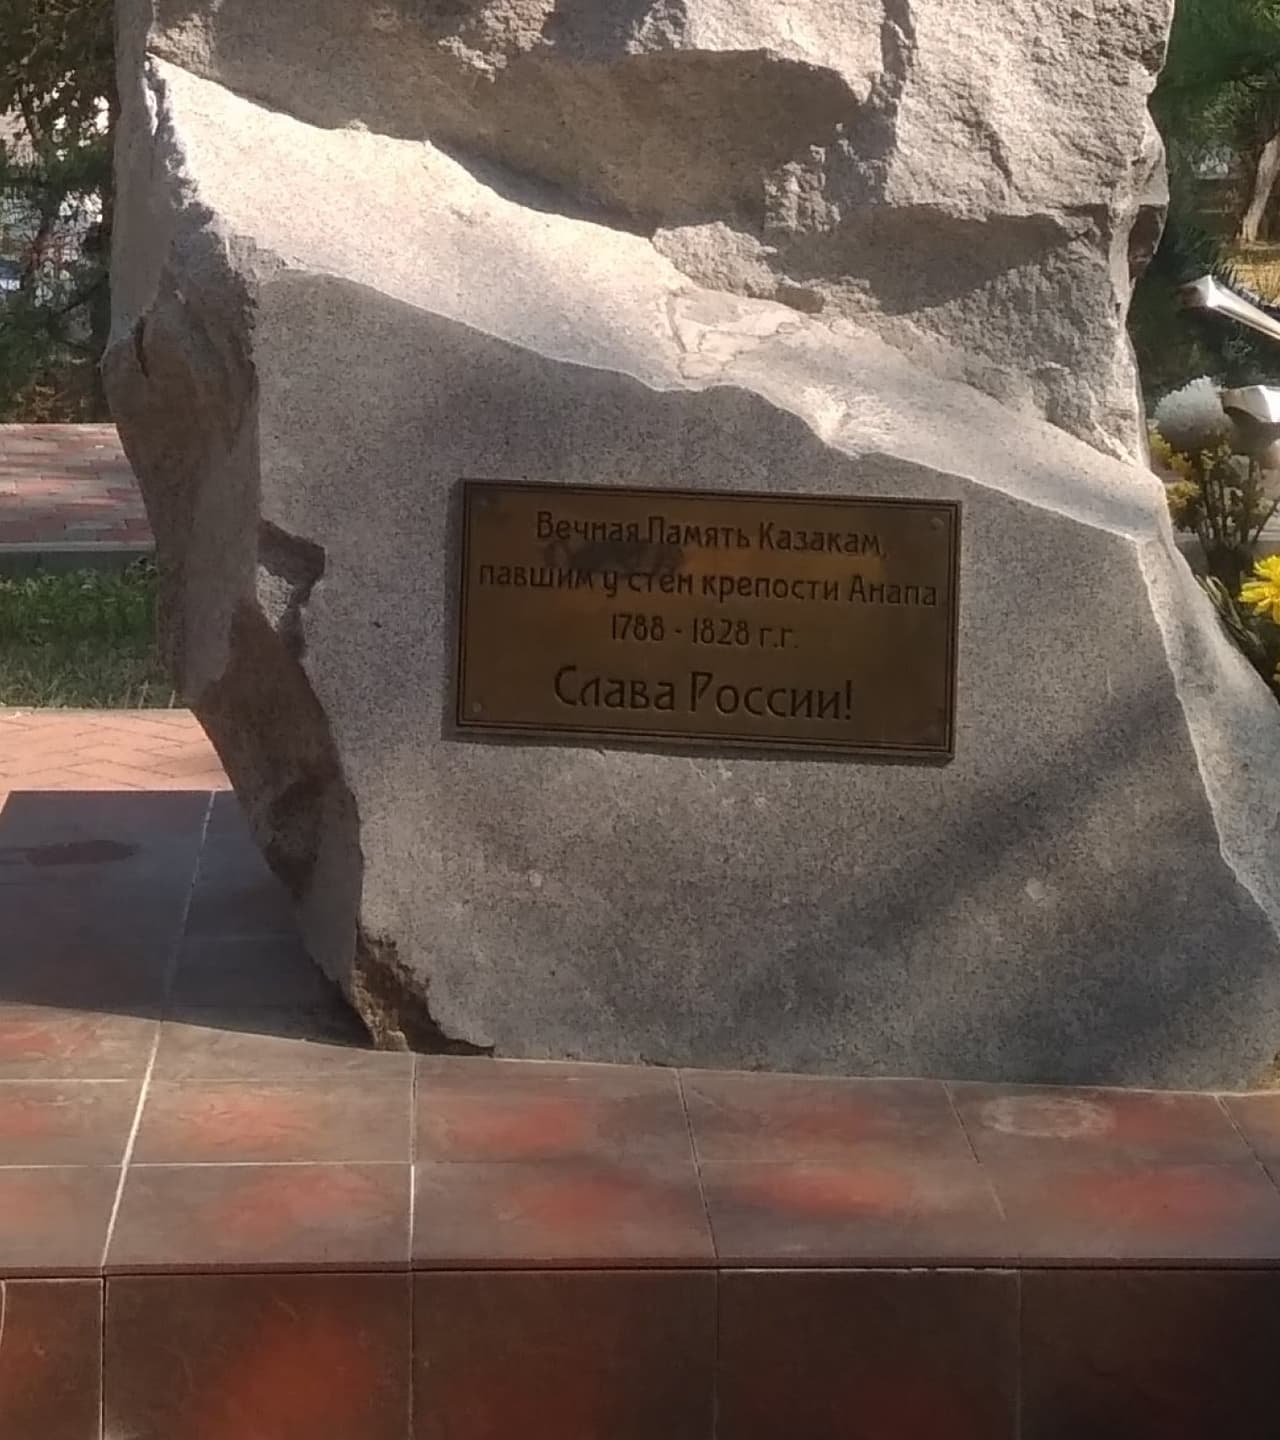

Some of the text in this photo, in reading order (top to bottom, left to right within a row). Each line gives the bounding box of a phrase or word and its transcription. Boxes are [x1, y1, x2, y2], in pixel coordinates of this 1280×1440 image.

[536, 511, 889, 558] Вечная Память Казакам,
[478, 563, 938, 607] павшим у стен крепости Анапа
[611, 612, 666, 642] 1788
[691, 616, 751, 647] 1828
[553, 664, 853, 721] Слава России!
